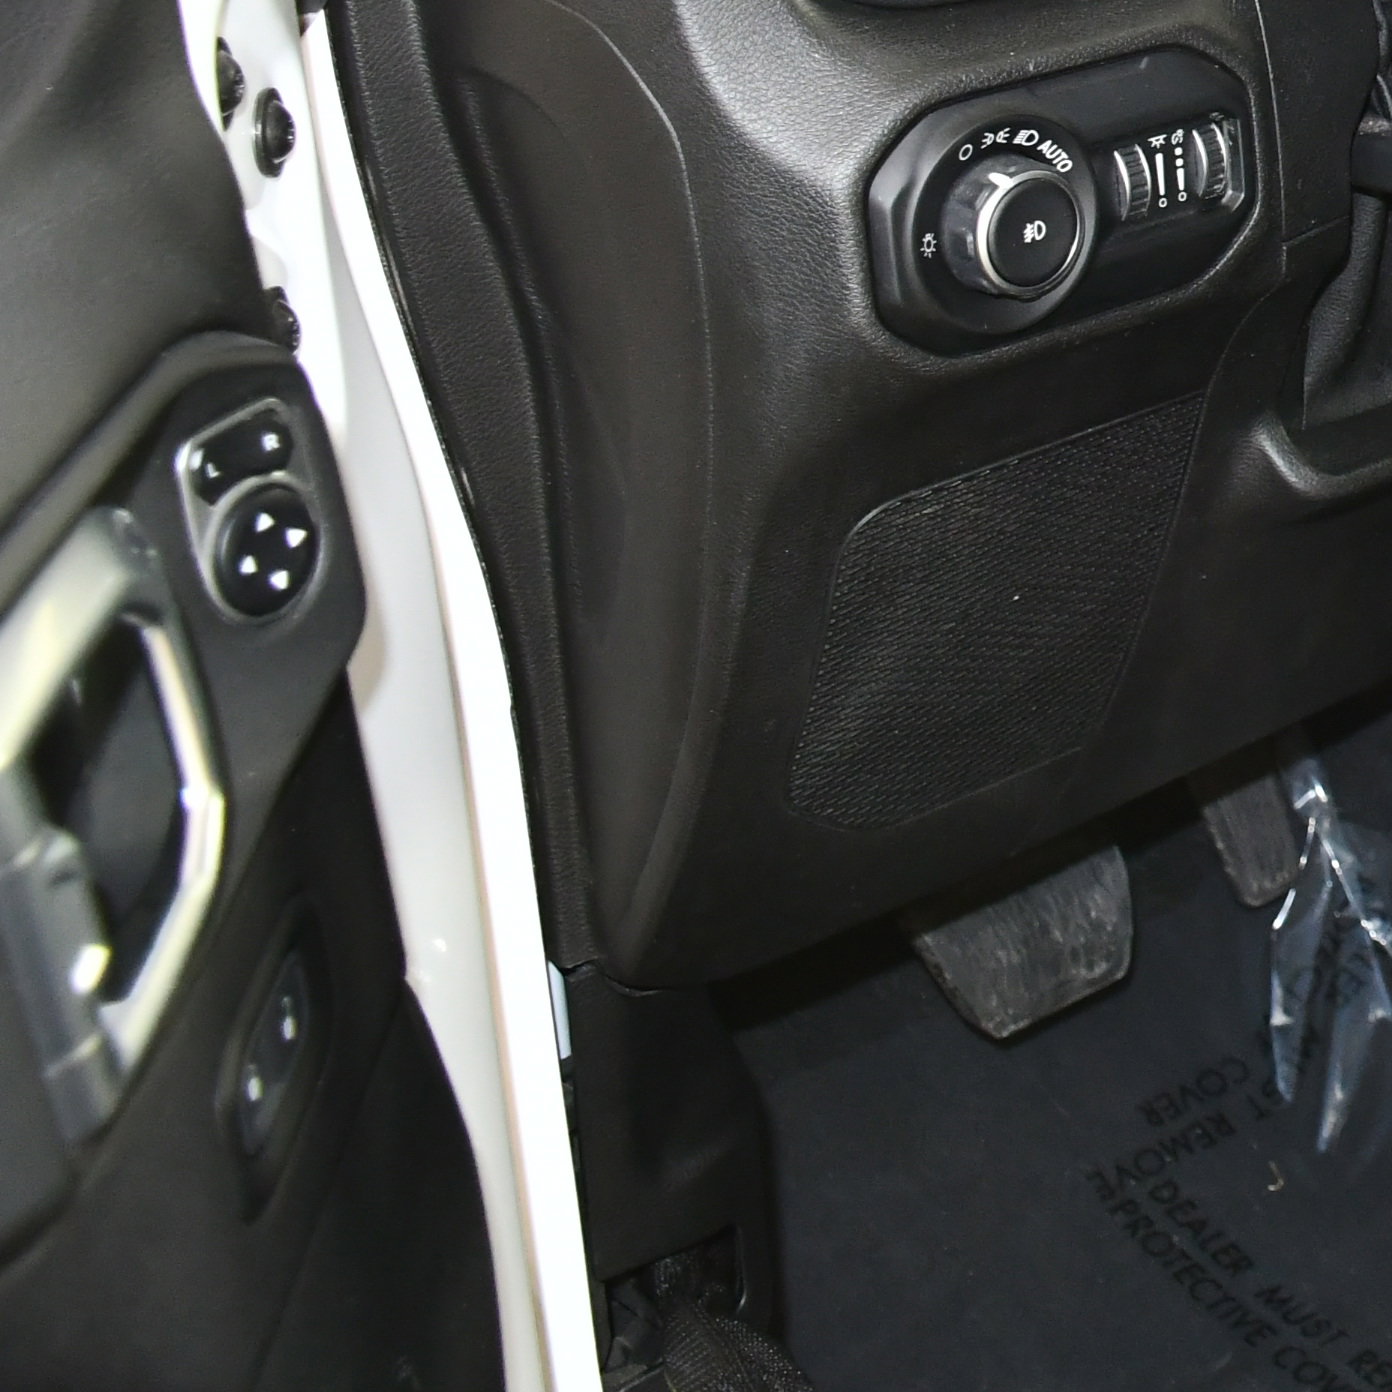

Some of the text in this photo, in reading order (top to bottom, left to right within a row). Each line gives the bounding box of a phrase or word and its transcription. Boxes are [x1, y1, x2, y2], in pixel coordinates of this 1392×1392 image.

[1036, 139, 1073, 173] AUTO
[262, 434, 281, 451] R
[206, 462, 219, 478] L
[1134, 1057, 1250, 1127] COVER
[1102, 1197, 1279, 1348] PROTECTIVE
[1147, 1177, 1254, 1277] DEALER
[1253, 1284, 1351, 1346] MUST
